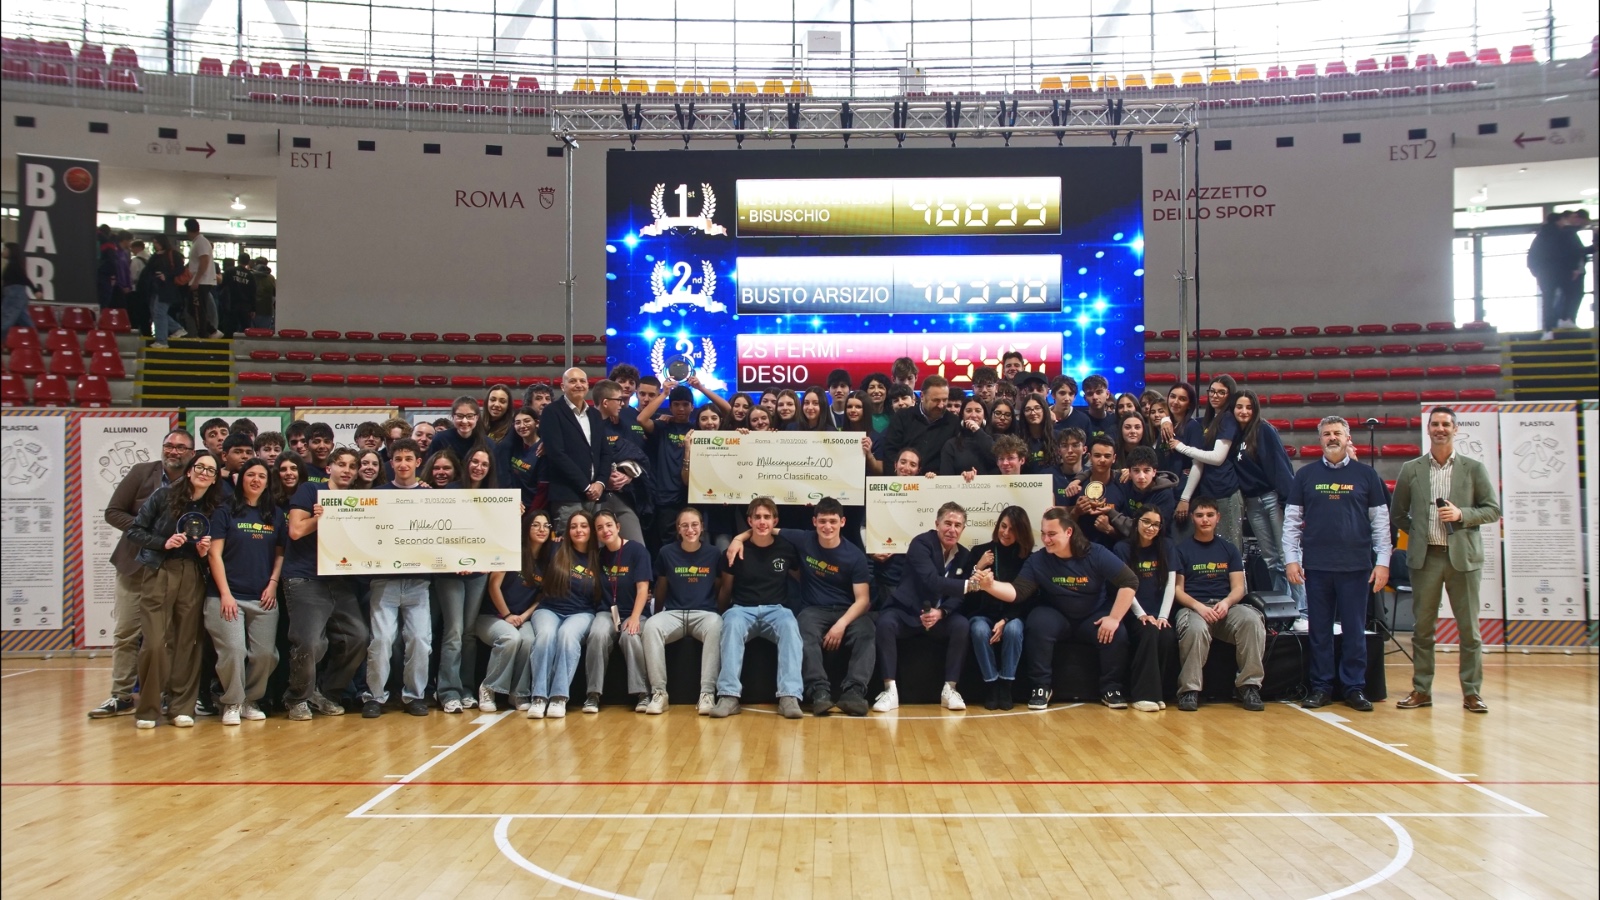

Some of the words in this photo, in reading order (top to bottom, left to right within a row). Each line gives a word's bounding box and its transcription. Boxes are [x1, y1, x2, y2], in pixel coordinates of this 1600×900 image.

[455, 190, 525, 209] ROMA
[1153, 185, 1267, 202] PALAZZETTO
[749, 209, 830, 222] BISUSCHIO
[1153, 207, 1211, 221] DELLO
[1216, 204, 1276, 219] SPORT
[24, 163, 57, 300] BAR
[741, 287, 808, 304] BUSTO
[812, 287, 890, 304] ARSIZIO
[742, 339, 768, 358] 2S
[774, 339, 841, 358] FERMI
[742, 365, 809, 383] DESIO
[693, 437, 711, 445] GREEN
[725, 437, 741, 445] GAME
[784, 472, 828, 480] Classificato
[869, 484, 888, 492] GREEN
[321, 498, 343, 506] GREEN
[360, 497, 379, 506] GAME
[409, 518, 452, 532] Mille/00
[966, 519, 998, 527] Classific
[394, 537, 434, 545] Secondo
[436, 536, 486, 545] Classificato
